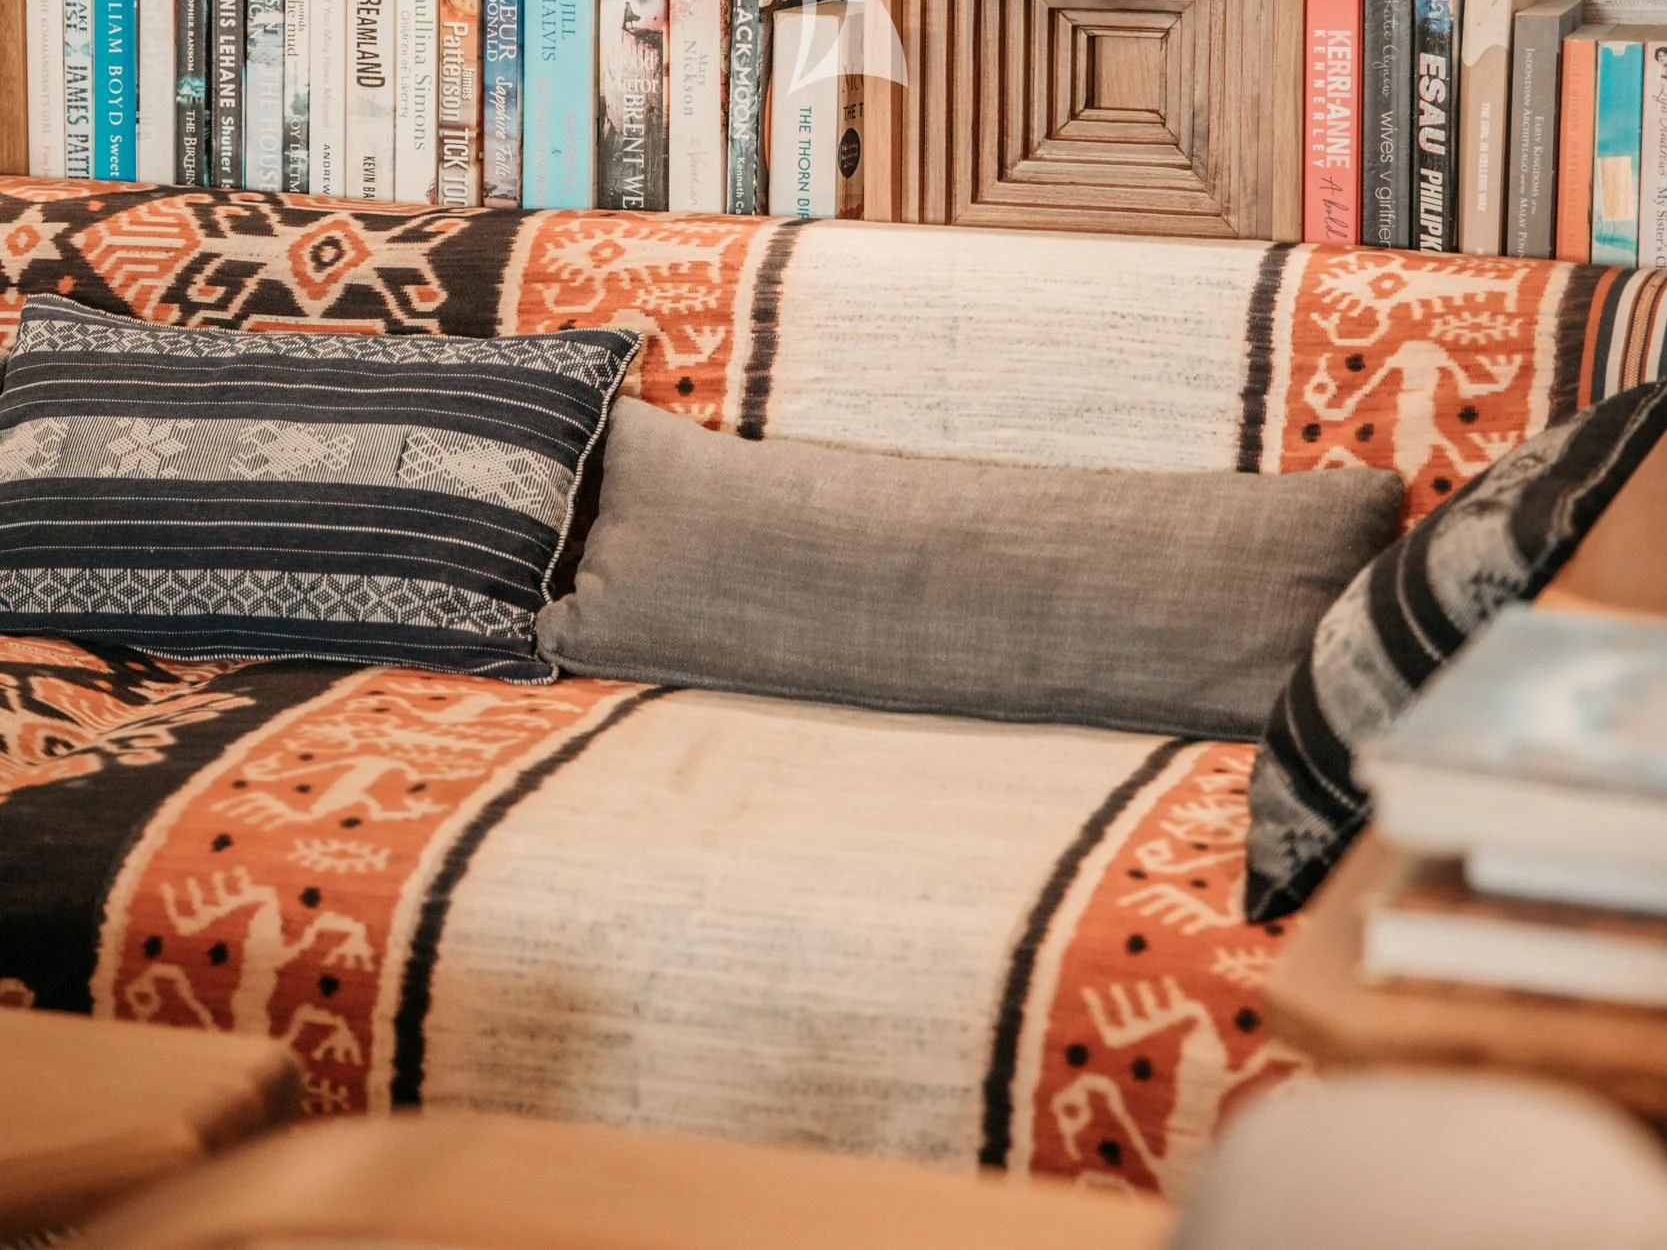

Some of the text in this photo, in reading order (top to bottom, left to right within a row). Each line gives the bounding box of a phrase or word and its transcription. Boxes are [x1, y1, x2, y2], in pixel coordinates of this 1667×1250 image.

[287, 22, 299, 55] mud
[322, 7, 333, 26] You
[401, 10, 411, 55] Children
[561, 1, 576, 39] JILL
[1384, 0, 1400, 38] Katie
[187, 31, 195, 70] RANSOM
[220, 35, 236, 107] LEHANE
[442, 21, 468, 121] Patterson
[699, 52, 708, 85] Mary
[66, 65, 90, 125] JAMES
[108, 65, 122, 126] BOYD
[400, 76, 411, 118] Liberty
[462, 65, 475, 99] James
[684, 39, 698, 116] Nickson
[734, 61, 750, 140] MOON
[1313, 30, 1325, 167] KENNERLEY
[1327, 30, 1352, 168] KERRI-ANNE
[1524, 48, 1536, 106] INDONESIAN
[186, 110, 196, 133] THE
[290, 114, 301, 138] JOY
[414, 73, 432, 150] Simons
[491, 76, 514, 178] Sapphire Falls
[799, 106, 811, 132] THE
[843, 105, 856, 120] THE
[1419, 52, 1447, 155] ESAU
[221, 116, 235, 171] Shutter
[443, 128, 469, 169] TICK
[623, 93, 645, 167] BRENT
[1381, 110, 1398, 161] wives
[1521, 108, 1532, 171] ARCHIPELAGO
[1534, 116, 1544, 142] EARLY
[109, 135, 122, 177] Sweet
[323, 144, 331, 193] ANDREW
[363, 156, 376, 199] KEVIN BA
[736, 157, 746, 197] Kenneth
[798, 138, 811, 191] THORN
[1531, 146, 1543, 196] KINGDOMS
[1320, 175, 1350, 238] A bold
[1421, 168, 1443, 232] PHILIP
[1519, 198, 1528, 228] MALAY
[1656, 210, 1667, 252] Sister's
